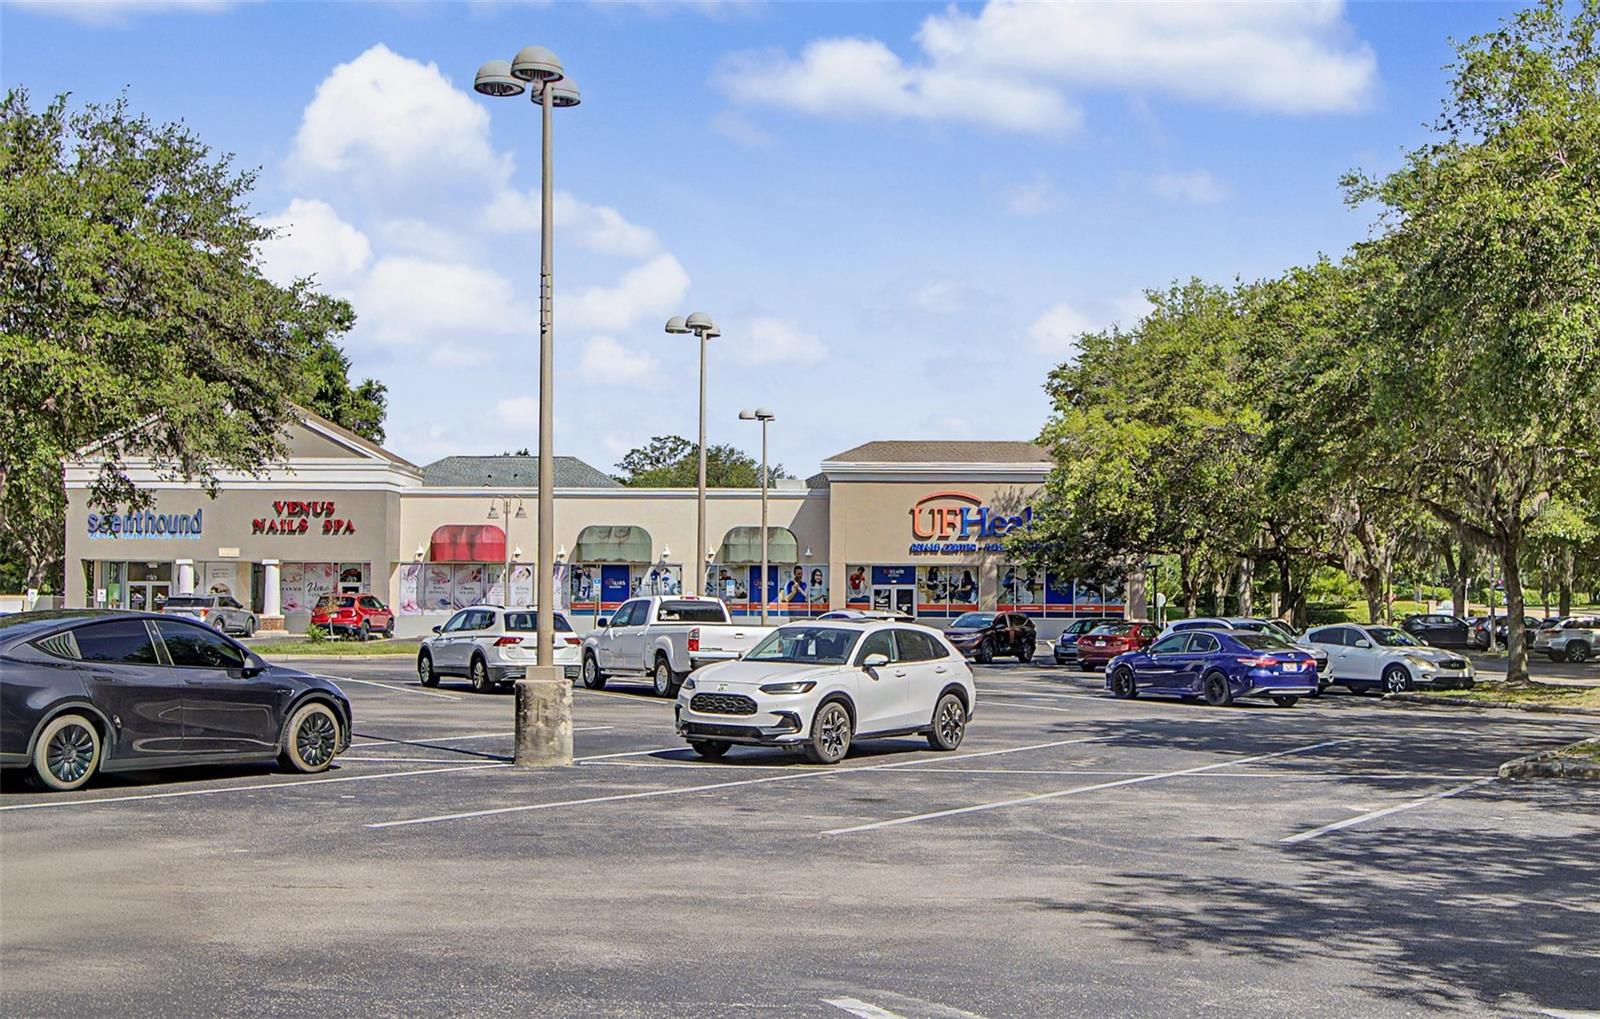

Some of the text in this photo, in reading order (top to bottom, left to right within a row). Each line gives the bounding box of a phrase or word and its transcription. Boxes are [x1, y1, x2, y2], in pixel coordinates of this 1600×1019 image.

[273, 501, 335, 518] VENUS
[87, 508, 202, 534] scenthound
[252, 518, 356, 535] NAILS SPA
[910, 506, 1041, 539] UFHeal
